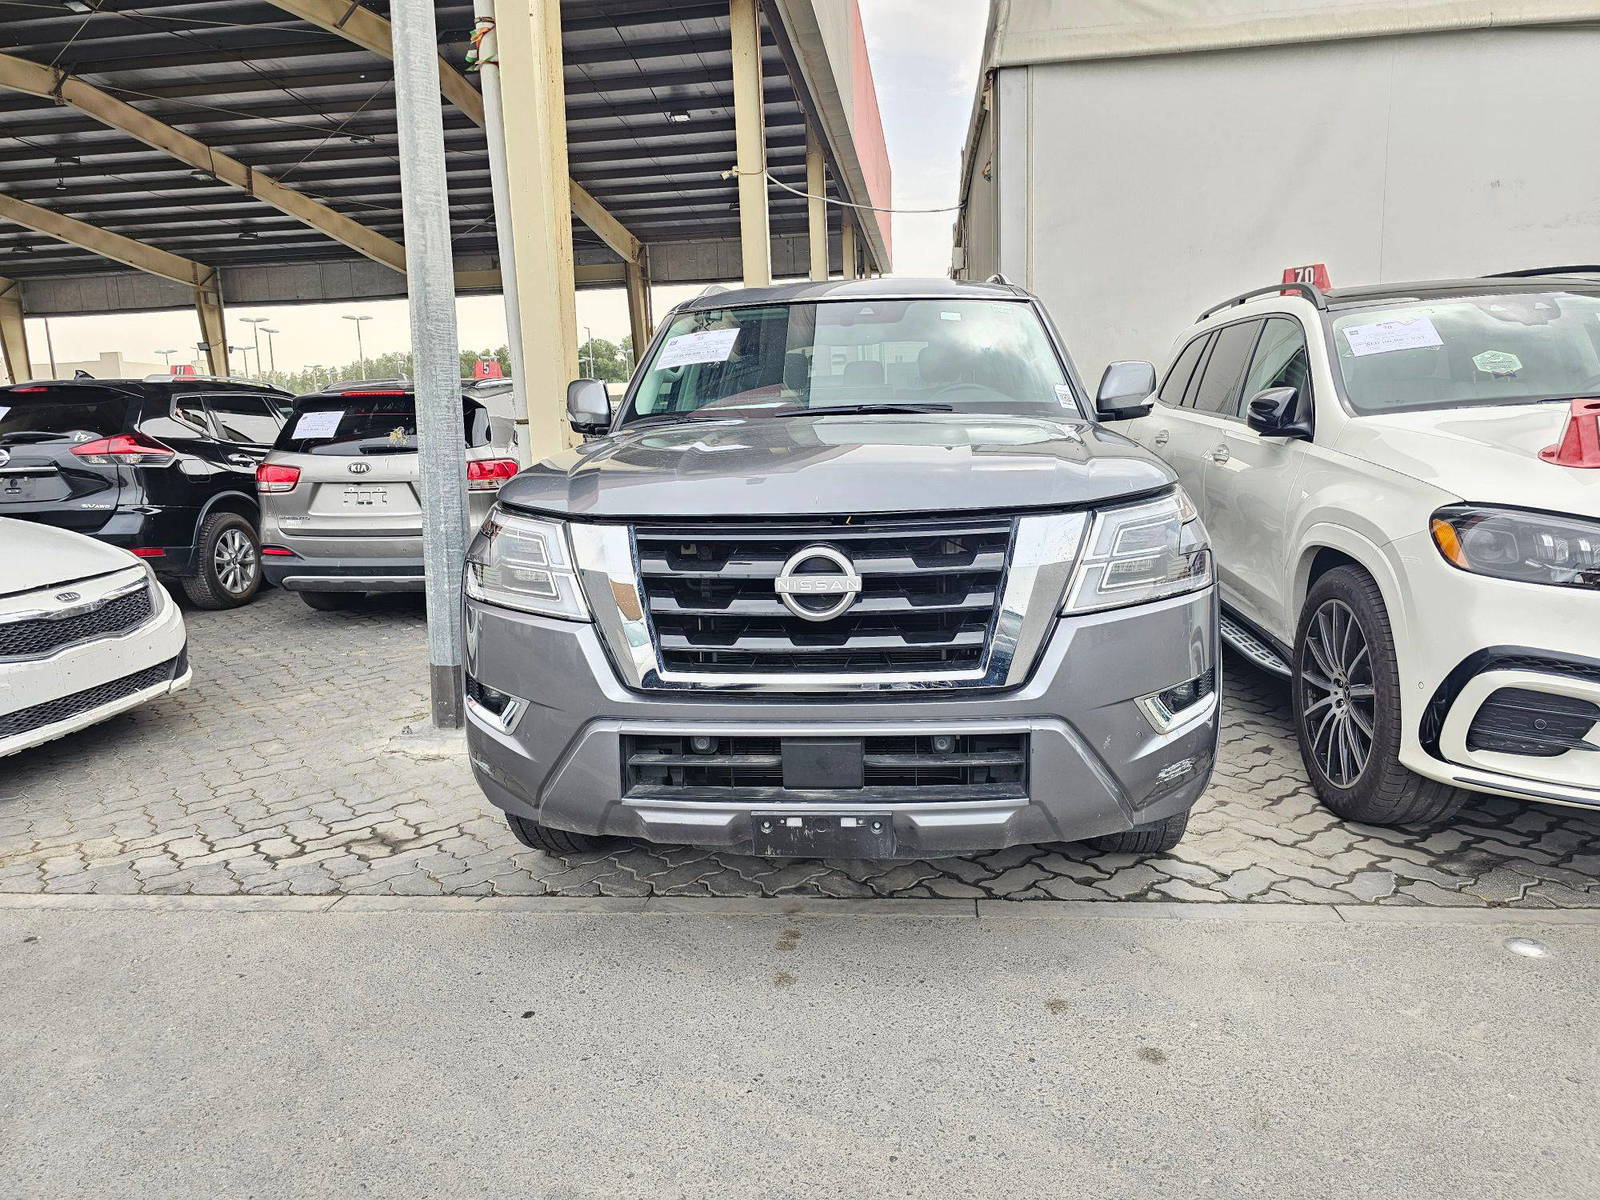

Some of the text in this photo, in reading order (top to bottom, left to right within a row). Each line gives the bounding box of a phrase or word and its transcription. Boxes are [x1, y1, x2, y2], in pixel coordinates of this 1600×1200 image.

[1294, 267, 1314, 283] 70
[483, 361, 489, 375] 5
[350, 464, 367, 472] KIA
[777, 580, 859, 591] NISSAN
[58, 593, 79, 601] KIA
